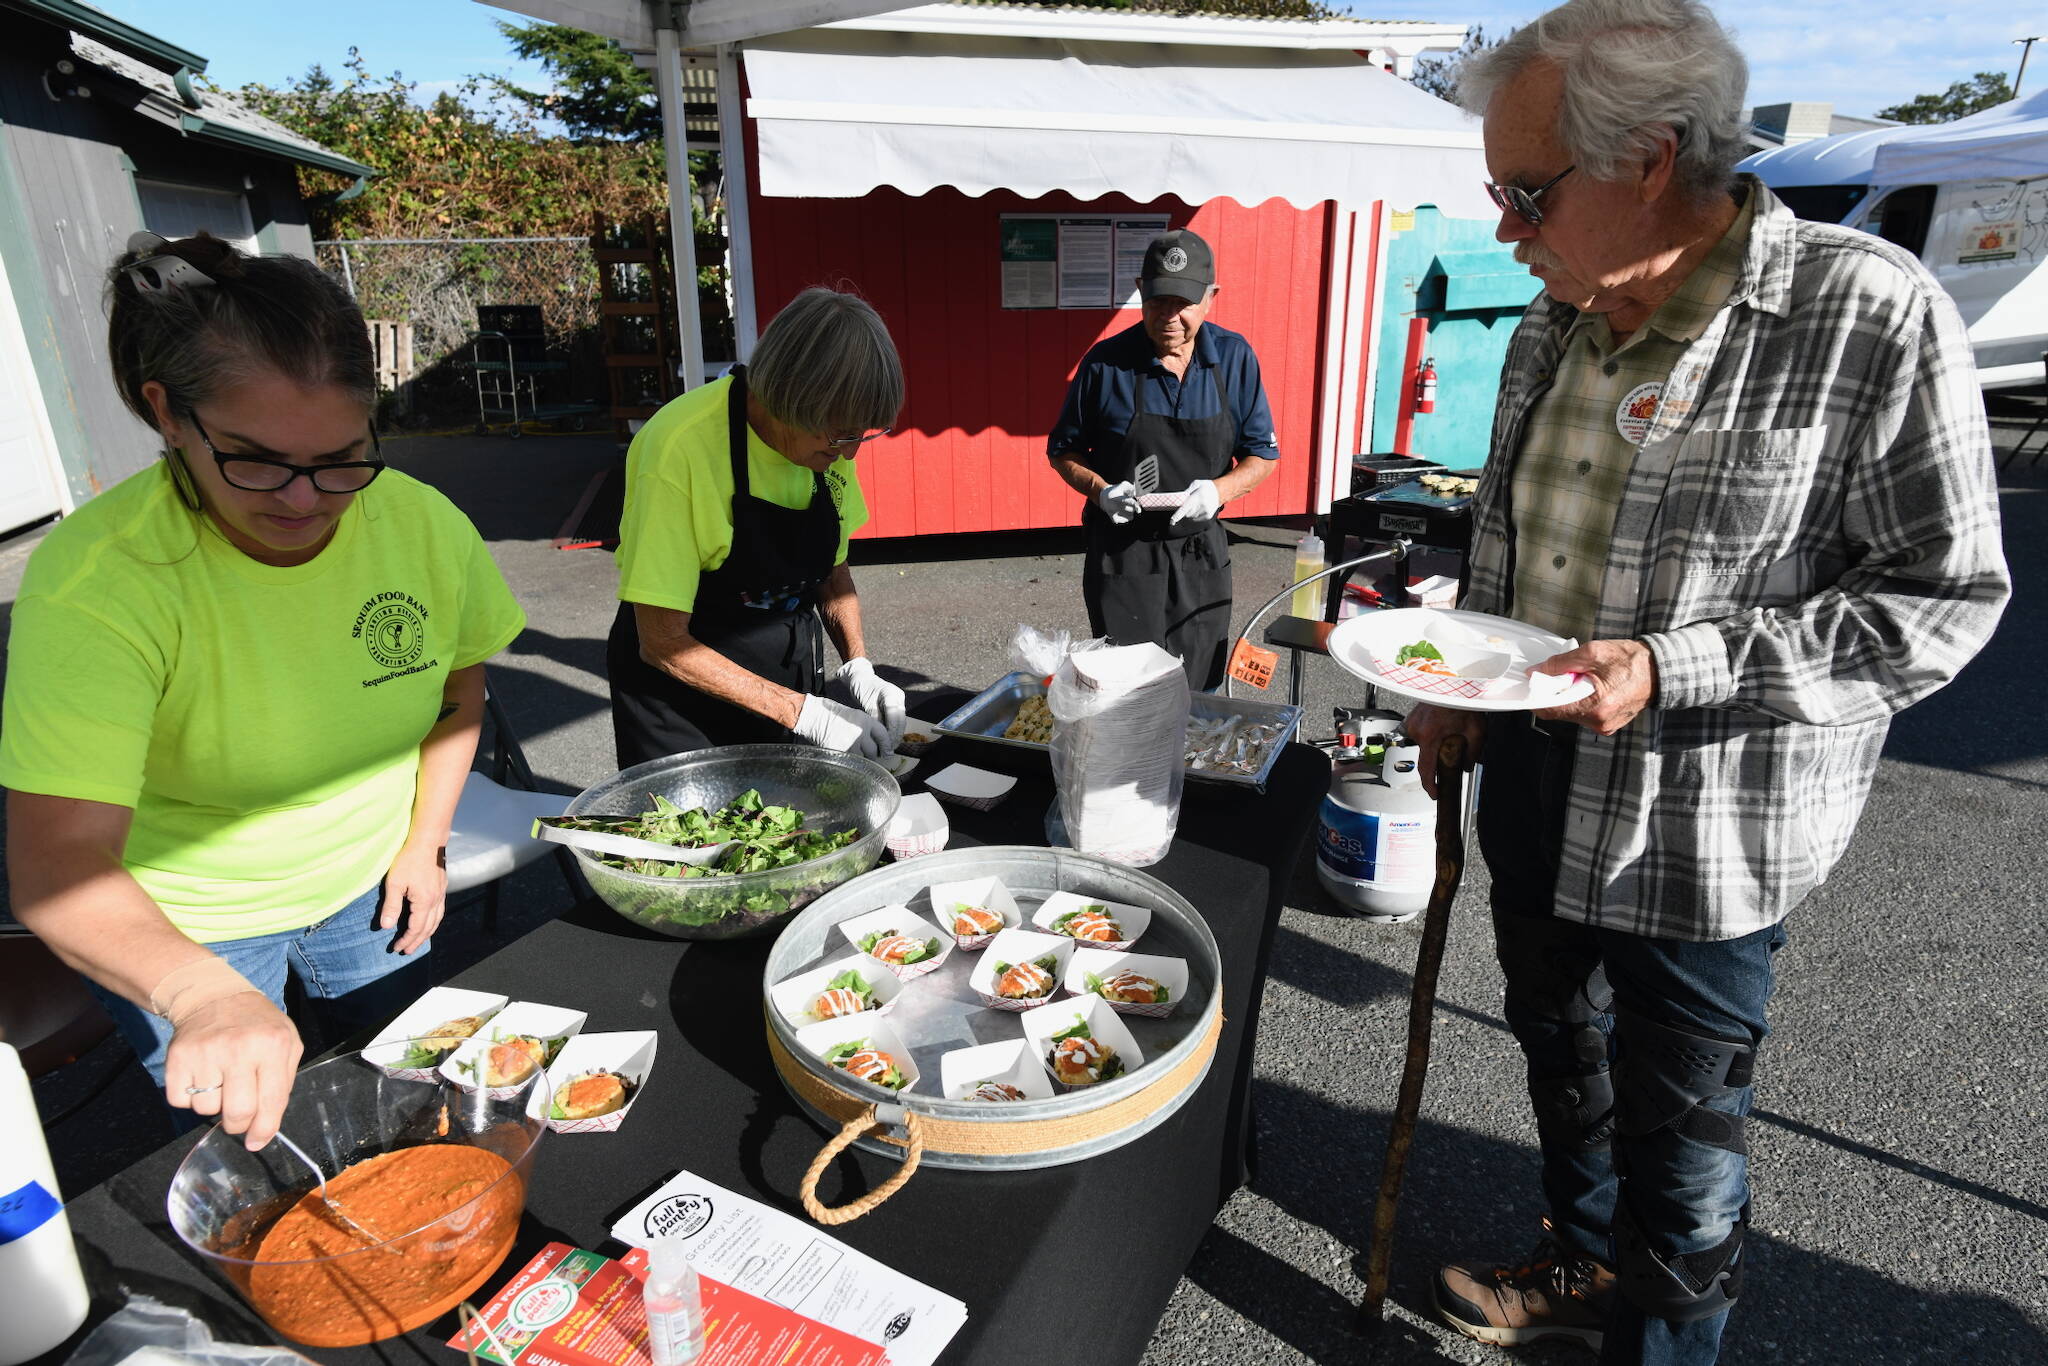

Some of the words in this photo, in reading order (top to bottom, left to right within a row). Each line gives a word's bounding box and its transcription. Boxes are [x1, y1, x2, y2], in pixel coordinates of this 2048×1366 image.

[352, 597, 377, 638] SEQUIM
[377, 591, 405, 602] FOOD
[406, 596, 429, 620] BANK
[653, 1205, 675, 1226] full
[659, 1200, 700, 1236] pantry
[685, 1225, 726, 1261] Grocery
[501, 1275, 530, 1302] FOOD
[528, 1250, 556, 1274] BANK
[521, 1295, 539, 1312] full
[528, 1288, 560, 1321] pantry
[558, 1327, 576, 1347] Full
[572, 1300, 602, 1332] Pantry
[597, 1272, 626, 1303] Project
